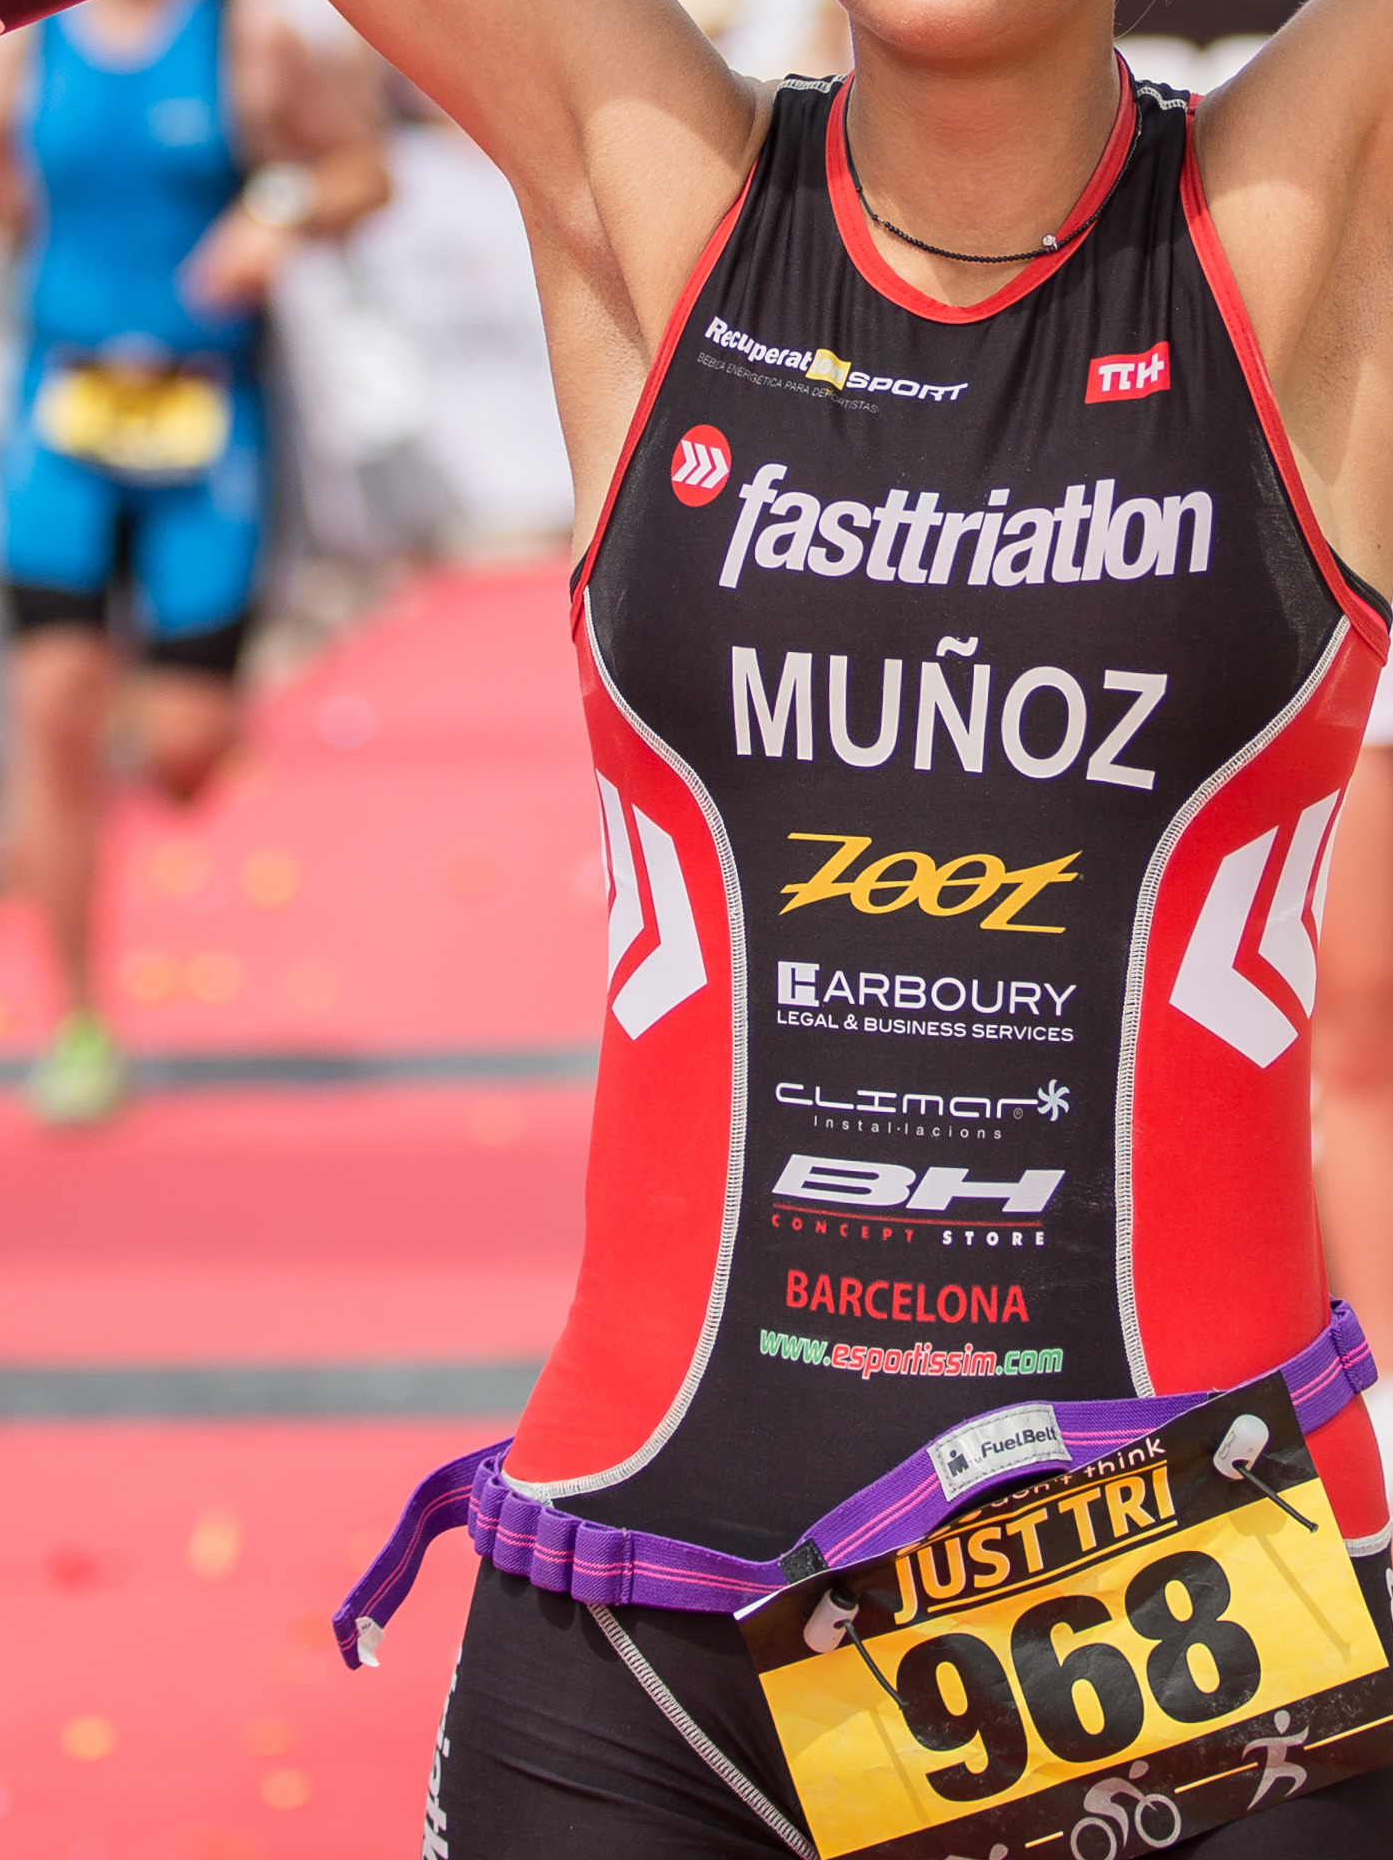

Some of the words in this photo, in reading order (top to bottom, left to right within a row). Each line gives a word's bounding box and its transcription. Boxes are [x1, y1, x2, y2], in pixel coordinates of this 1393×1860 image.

[730, 636, 1169, 791] MUÑOZ
[777, 960, 1077, 1017] HARBOURY
[777, 1009, 839, 1030] LEGAL
[843, 1014, 859, 1031] &
[863, 1016, 967, 1037] BUSINESS
[971, 1023, 1074, 1042] SERVICES
[772, 1153, 1066, 1213] BH
[771, 1214, 914, 1243] CONCEPT
[942, 1229, 1045, 1246] STORE
[785, 1269, 1029, 1324] BARCELONA
[759, 1328, 1064, 1381] www.esportissim.com
[980, 1426, 1057, 1460] FuelBelt
[1083, 1437, 1166, 1478] think
[894, 1507, 1049, 1625] JUST
[1058, 1466, 1176, 1553] TRI
[896, 1550, 1262, 1803] 968
